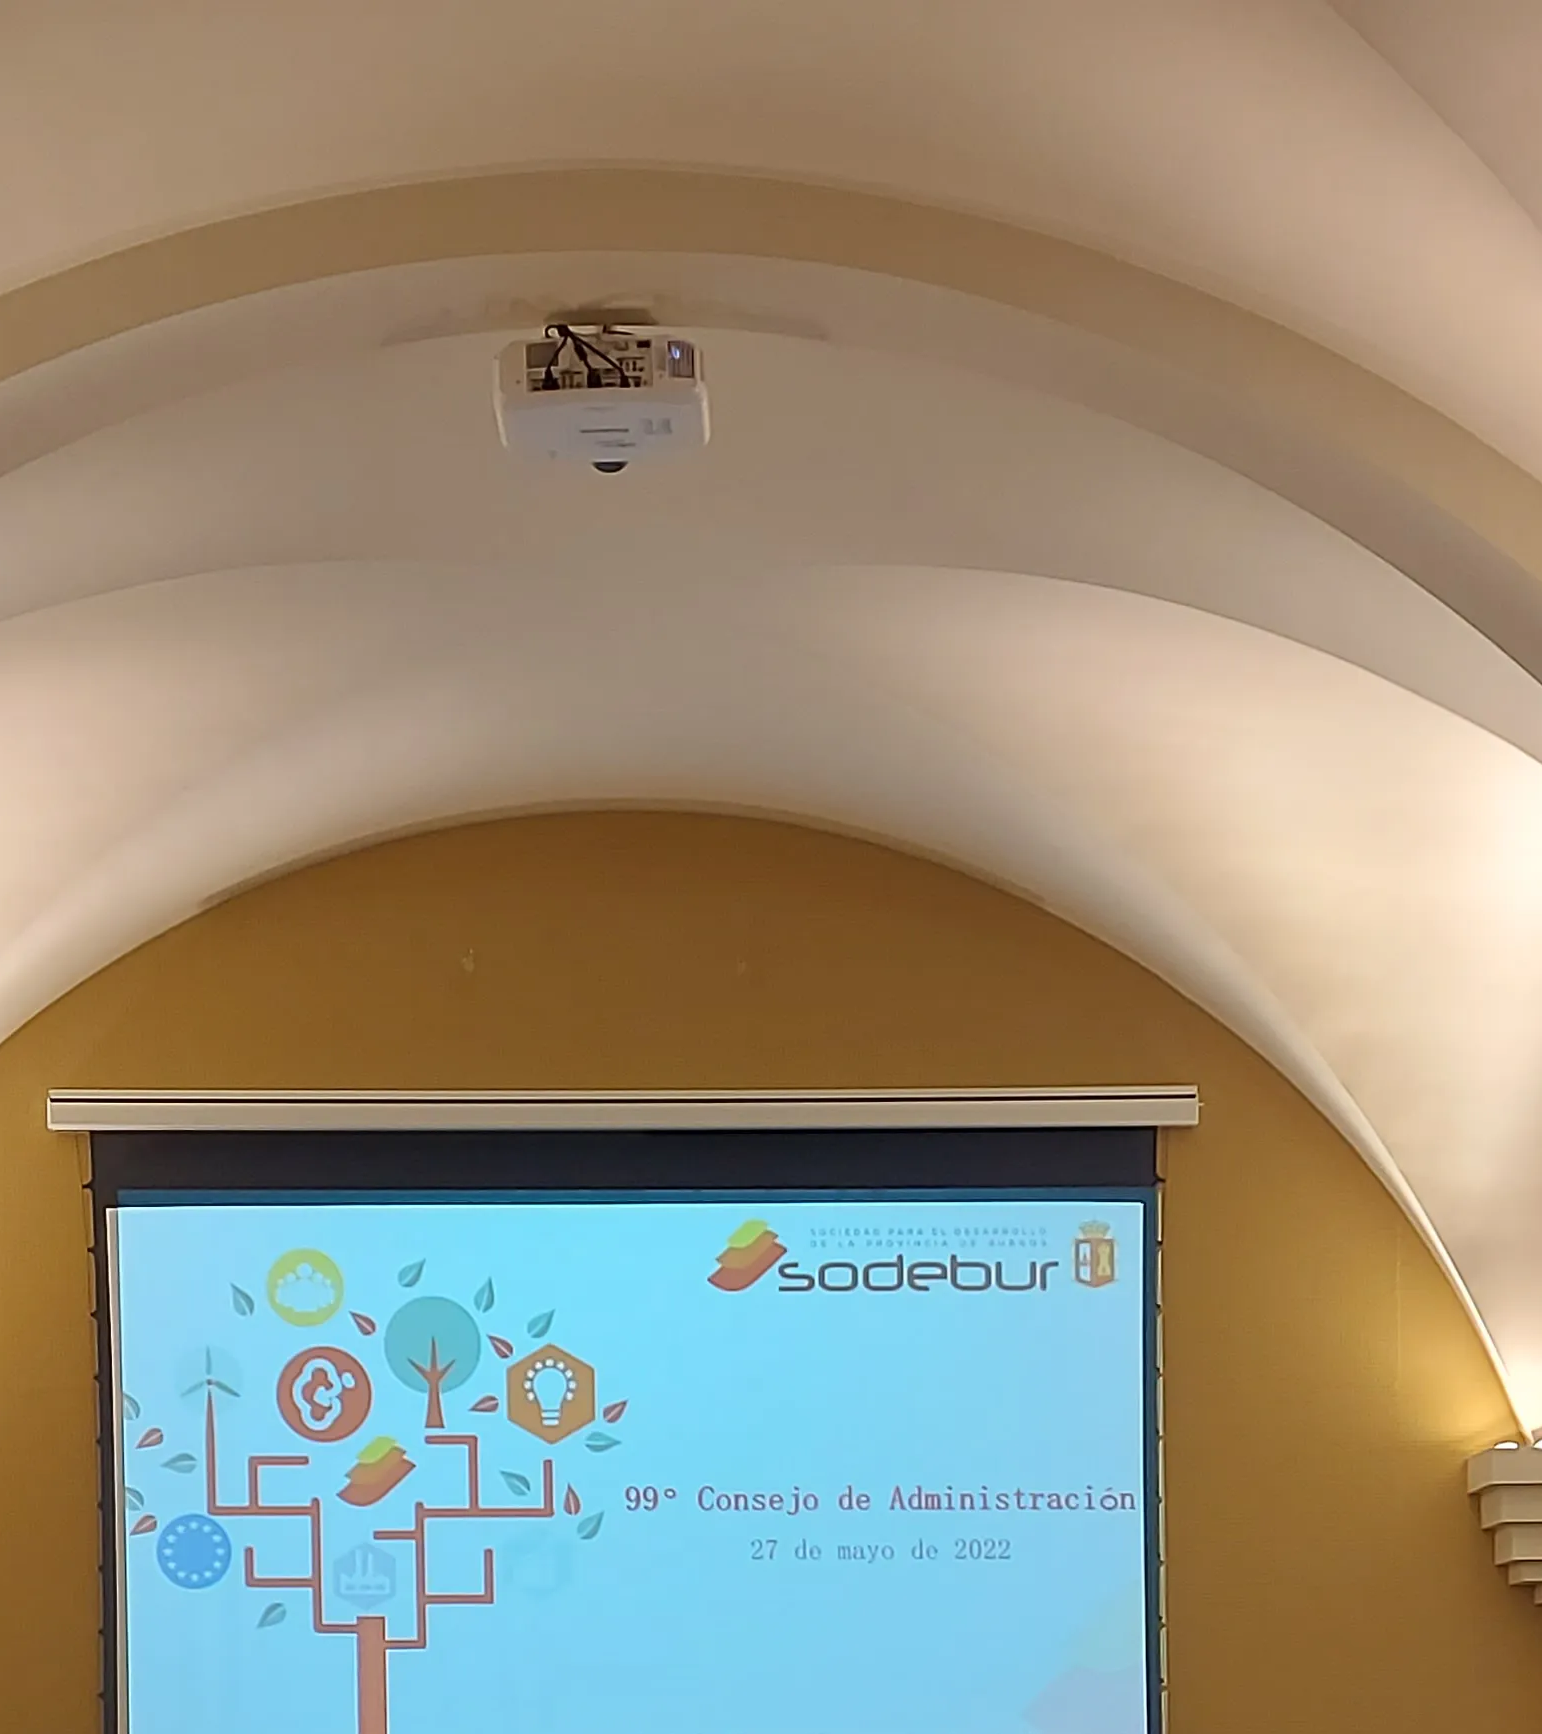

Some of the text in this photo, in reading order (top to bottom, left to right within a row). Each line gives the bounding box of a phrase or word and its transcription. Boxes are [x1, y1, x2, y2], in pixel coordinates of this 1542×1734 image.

[778, 1254, 1060, 1293] sodebur
[697, 1485, 820, 1516] Consejo
[838, 1484, 871, 1511] de
[889, 1484, 1137, 1511] Administración
[750, 1538, 1012, 1564] 27 de mayo de 2022
